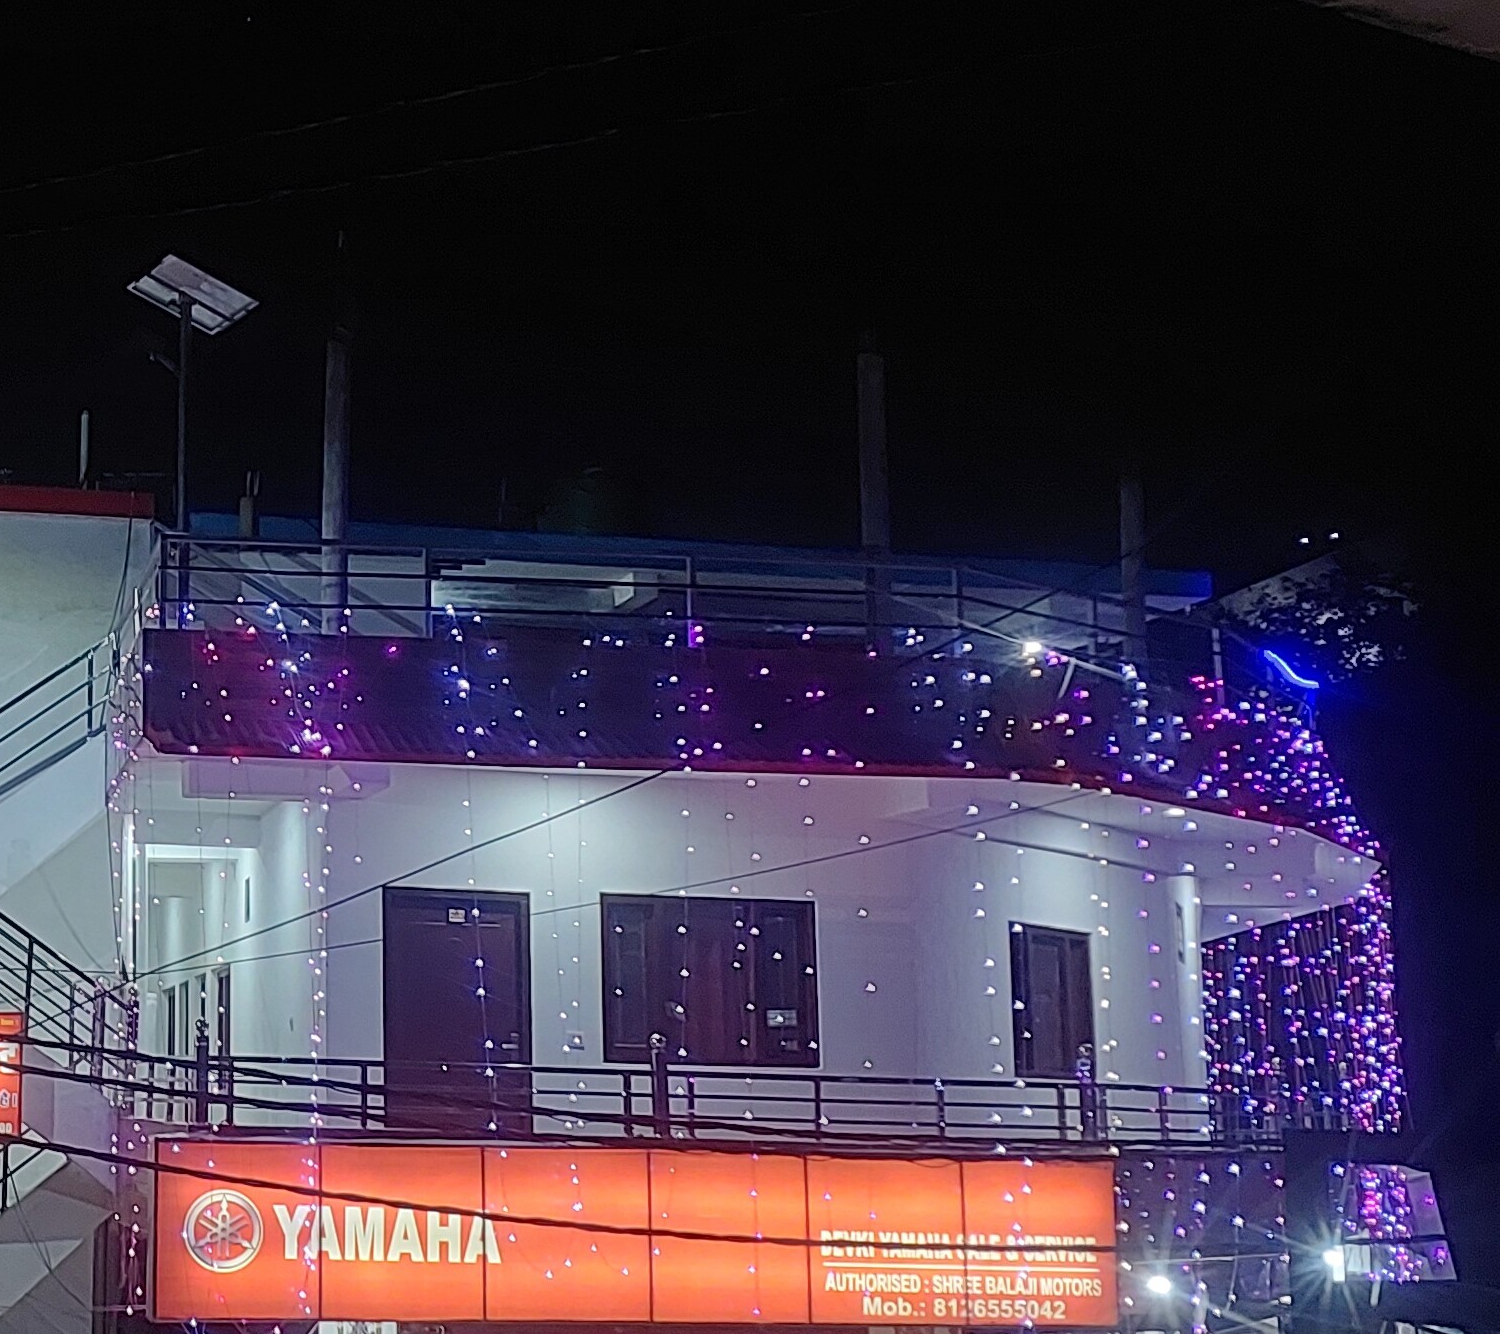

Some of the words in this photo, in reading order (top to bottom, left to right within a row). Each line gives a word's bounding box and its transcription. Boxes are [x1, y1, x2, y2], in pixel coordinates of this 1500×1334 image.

[273, 1204, 503, 1265] YAMAHA
[820, 1230, 874, 1257] DEVKI
[879, 1231, 953, 1259] YAMAHA
[1023, 1235, 1097, 1262] SERVICE
[825, 1272, 921, 1293] AUTHORISED
[932, 1274, 982, 1294] SHREE
[986, 1276, 1037, 1296] BALAJI
[1040, 1277, 1102, 1297] MOTORS
[933, 1298, 1066, 1319] 8126555042
